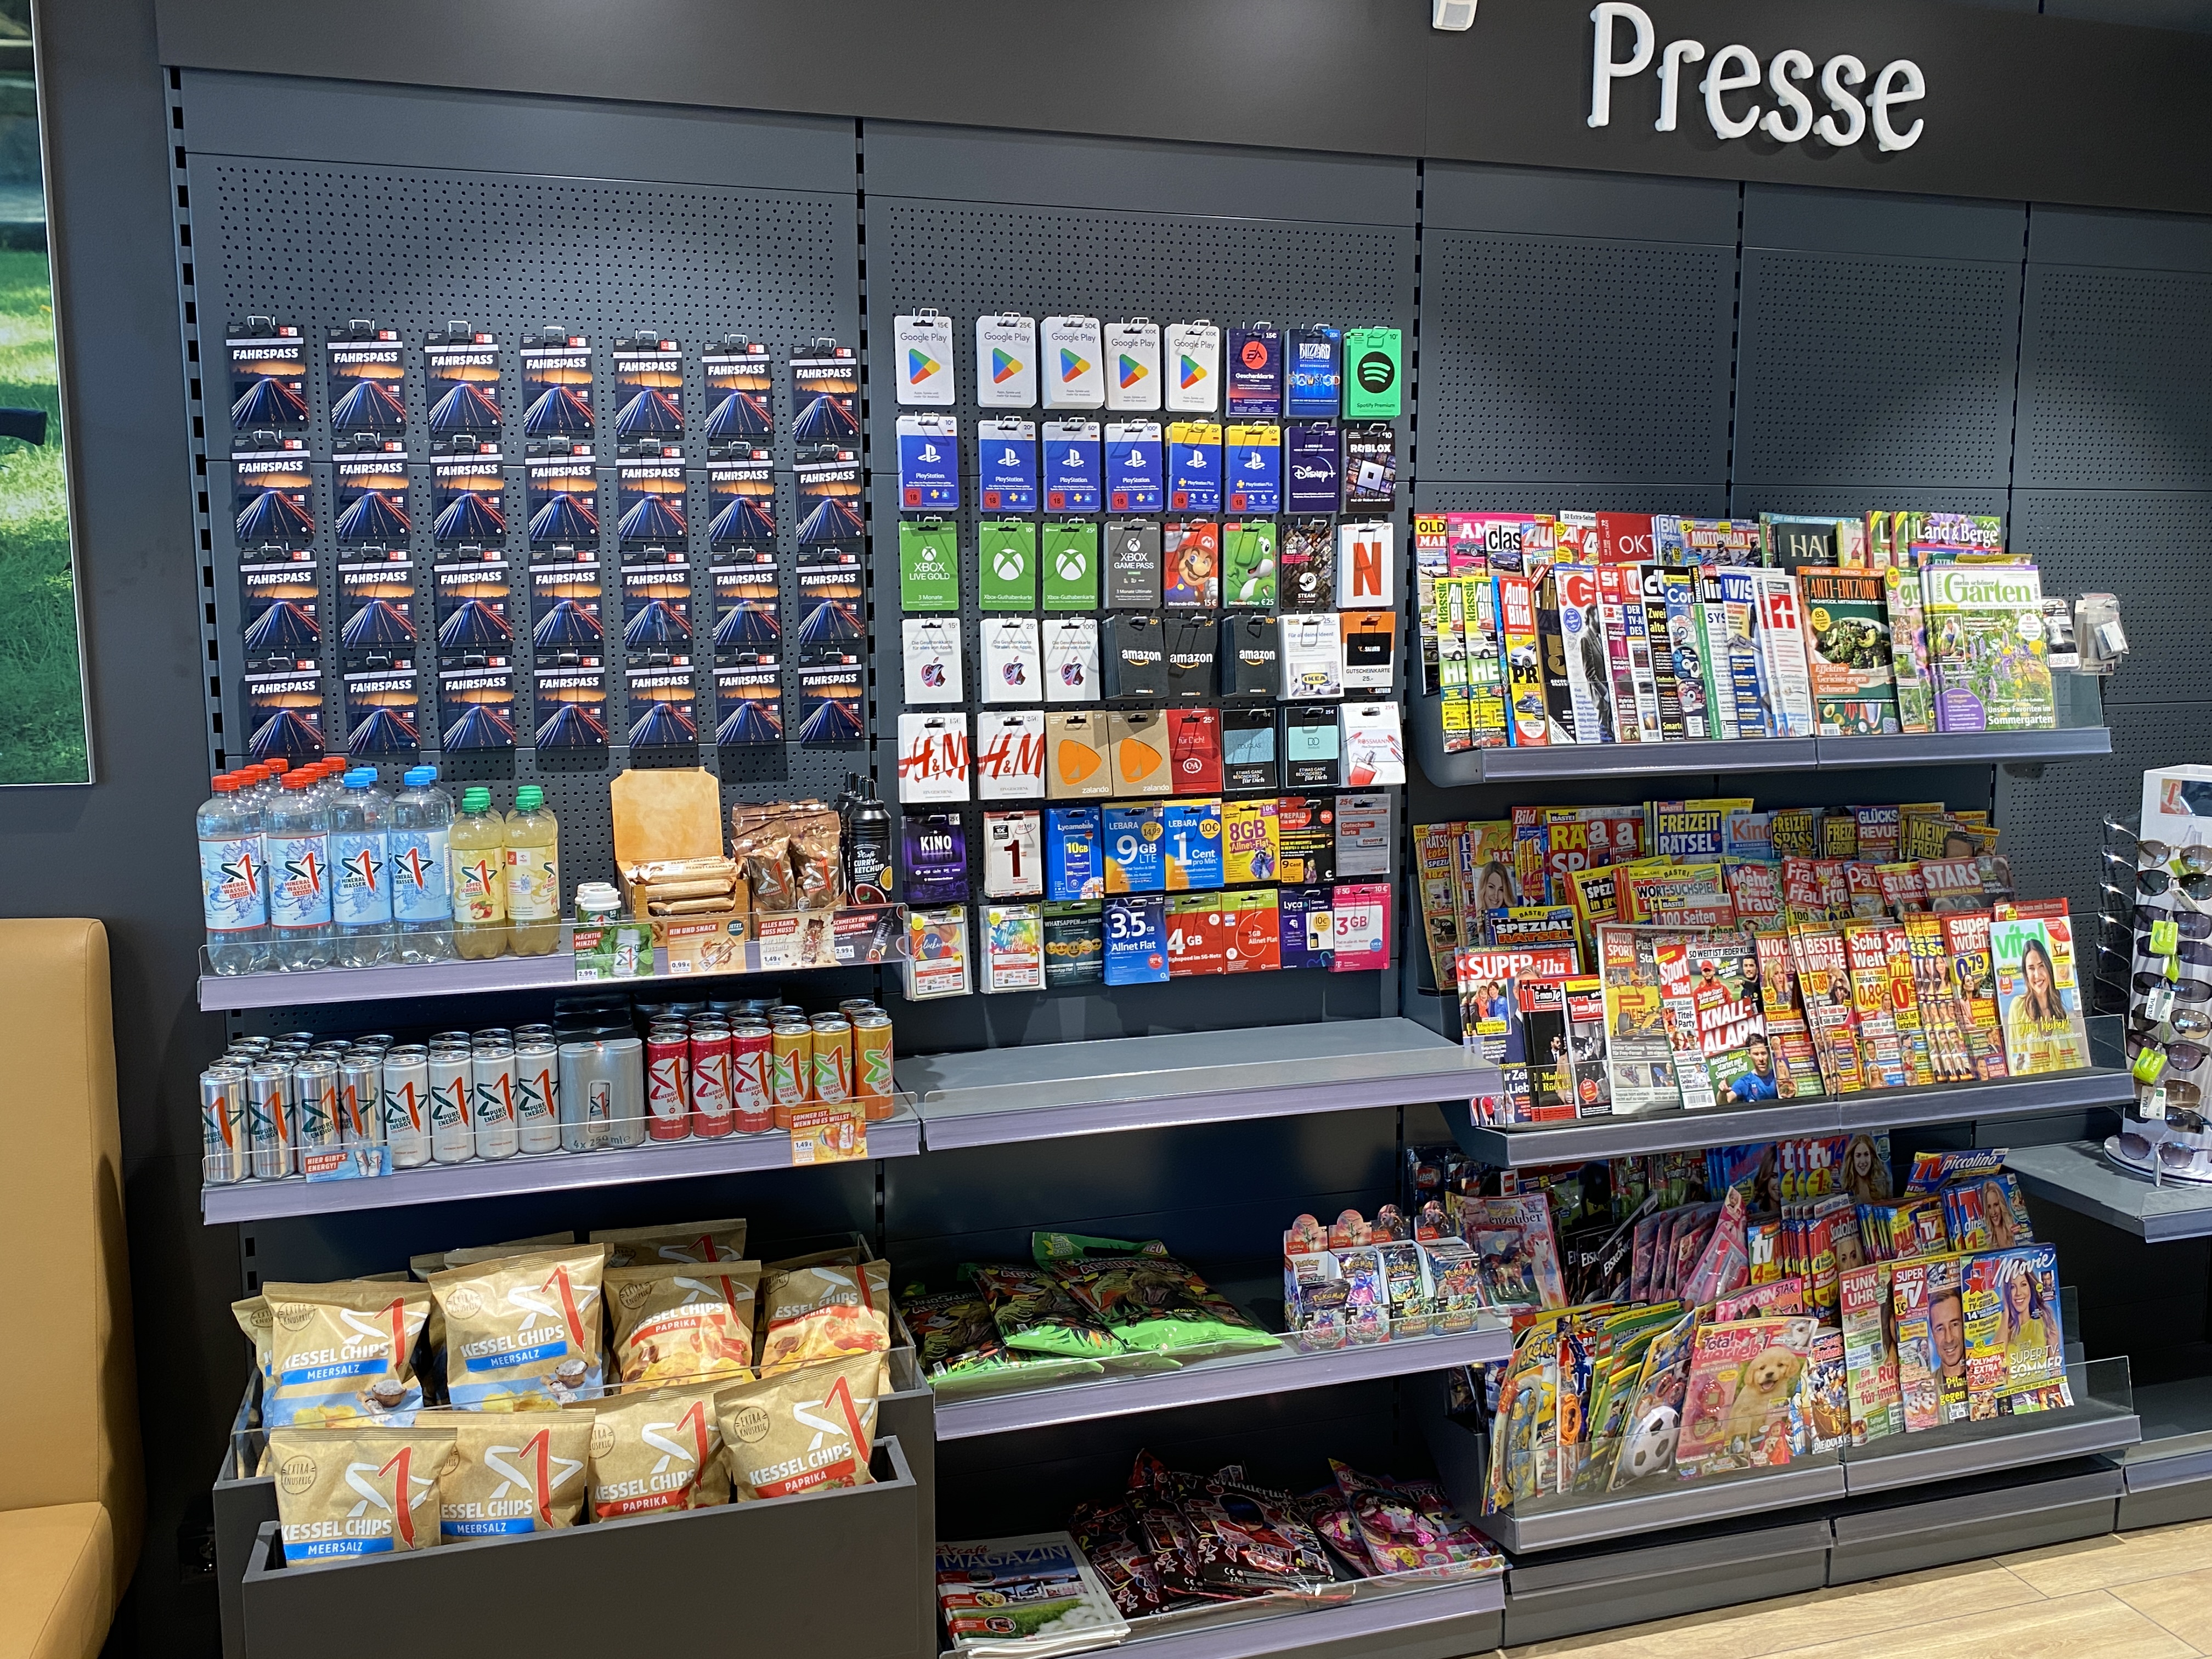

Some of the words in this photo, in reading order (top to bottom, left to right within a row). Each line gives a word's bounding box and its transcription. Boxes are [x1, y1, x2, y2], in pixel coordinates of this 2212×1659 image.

[1587, 2, 1925, 151] Presse
[900, 332, 929, 341] Google
[932, 334, 947, 343] Play
[984, 332, 1013, 341] Google
[1015, 332, 1030, 342] Play
[1052, 333, 1078, 342] Google
[1080, 334, 1095, 343] Play
[233, 348, 298, 360] FAHRSPASS
[1299, 343, 1331, 359] BLIZZARD
[431, 354, 493, 366] FAHRSPASS
[618, 361, 678, 372] FAHRSPASS
[796, 368, 852, 379] FAHRSPASS
[1350, 444, 1391, 453] ROBLOX
[340, 462, 403, 475] FAHRSPASS
[531, 465, 591, 478] FAHRSPASS
[712, 470, 769, 481] FAHRSPASS
[1692, 531, 1742, 545] MOTORRAD
[1917, 520, 1950, 539] Land
[1953, 527, 1959, 540] &
[1961, 523, 1998, 548] Berge
[914, 563, 945, 572] XBOX
[247, 572, 311, 585] FAHRSPASS
[441, 571, 502, 585] FAHRSPASS
[627, 573, 685, 585] FAHRSPASS
[801, 573, 856, 585] FAHRSPASS
[1945, 573, 2030, 602] Garten
[1504, 584, 1527, 606] Auto
[1438, 582, 1448, 623] klassik
[1508, 607, 1530, 625] Bild
[1121, 650, 1161, 662] amazon
[1170, 653, 1212, 663] amazon
[350, 679, 412, 693] FAHRSPASS
[539, 676, 599, 689] FAHRSPASS
[719, 674, 775, 687] FAHRSPASS
[1847, 675, 1866, 684] gegen
[1988, 715, 2052, 726] Sommergarten
[899, 731, 970, 782] H&M
[1551, 814, 1575, 822] BASTEI
[1660, 812, 1721, 833] FREIZEIT
[1858, 808, 1898, 824] GLÜCKS
[1109, 822, 1138, 830] LEBARA
[1771, 813, 1813, 833] FREIZEIT
[1230, 820, 1266, 840] 8GB
[1859, 827, 1898, 838] REVUE
[921, 836, 952, 851] KINO
[1231, 839, 1269, 851] Allnet-Flat
[1660, 833, 1716, 854] RÄTSEL
[1773, 831, 1813, 850] SPASS
[1116, 835, 1138, 865] 9
[1139, 844, 1156, 853] GB
[1173, 832, 1192, 866] 1
[854, 859, 878, 868] CURRY-
[1140, 854, 1157, 863] LTE
[855, 864, 884, 874] KETCHUP
[1922, 862, 1980, 889] STARS
[221, 880, 248, 890] MINERAL
[222, 885, 249, 895] WASSER
[1284, 901, 1302, 910] Lyca
[833, 917, 857, 926] SCHMECKT
[1111, 912, 1146, 939] 3,5
[1496, 919, 1571, 934] SPEZIAL
[696, 924, 716, 933] SNACK
[1167, 929, 1186, 954] 4
[1187, 935, 1203, 946] GB
[1498, 930, 1572, 944] RÄTSEL
[1607, 934, 1632, 945] MOTOR
[1111, 941, 1138, 951] Allnet
[1140, 941, 1156, 949] Flat
[1608, 945, 1633, 958] SPORT
[1720, 947, 1737, 956] JEDER
[1739, 946, 1754, 955] KLUB
[1807, 937, 1845, 954] BESTE
[1608, 955, 1634, 965] aktuell
[1810, 952, 1846, 971] WOCHE
[1467, 953, 1533, 981] SUPER
[1537, 958, 1565, 975] illu
[1660, 953, 1688, 986] Sport
[1672, 980, 1690, 996] Bild
[1678, 1011, 1694, 1020] Titel-
[1701, 998, 1752, 1031] KNALL-
[1678, 1019, 1695, 1029] Party
[1703, 1014, 1764, 1052] ALARM
[793, 1112, 817, 1121] SOMMER
[829, 1114, 849, 1122] WILLST
[307, 1156, 326, 1166] HIER
[308, 1163, 336, 1171] ENERGY!
[1943, 1153, 1997, 1170] piccolino
[1895, 1267, 1923, 1283] SUPER
[1993, 1254, 2056, 1287] Movie
[1843, 1274, 1878, 1294] FUNK
[1848, 1290, 1876, 1307] UHR
[460, 1336, 516, 1358] KESSEL
[518, 1325, 565, 1347] CHIPS
[490, 1349, 540, 1367] MEERSALZ
[2010, 1344, 2059, 1364] SUPER-TV-
[1973, 1356, 2001, 1366] OLYMPIA
[2010, 1356, 2062, 1379] SOMMER
[307, 1364, 359, 1379] MEERSALZ
[1974, 1364, 1997, 1374] EXTRA
[741, 1413, 760, 1425] EXTRA
[740, 1424, 766, 1437] KNUSPRIG
[749, 1458, 807, 1485] KESSEL
[809, 1442, 852, 1468] CHIPS
[785, 1471, 827, 1491] PAPRIKA
[281, 1522, 342, 1541] KESSEL
[345, 1520, 392, 1535] CHIPS
[308, 1542, 363, 1555] MEERSALZ
[943, 1545, 1073, 1567] MAGAZIN
